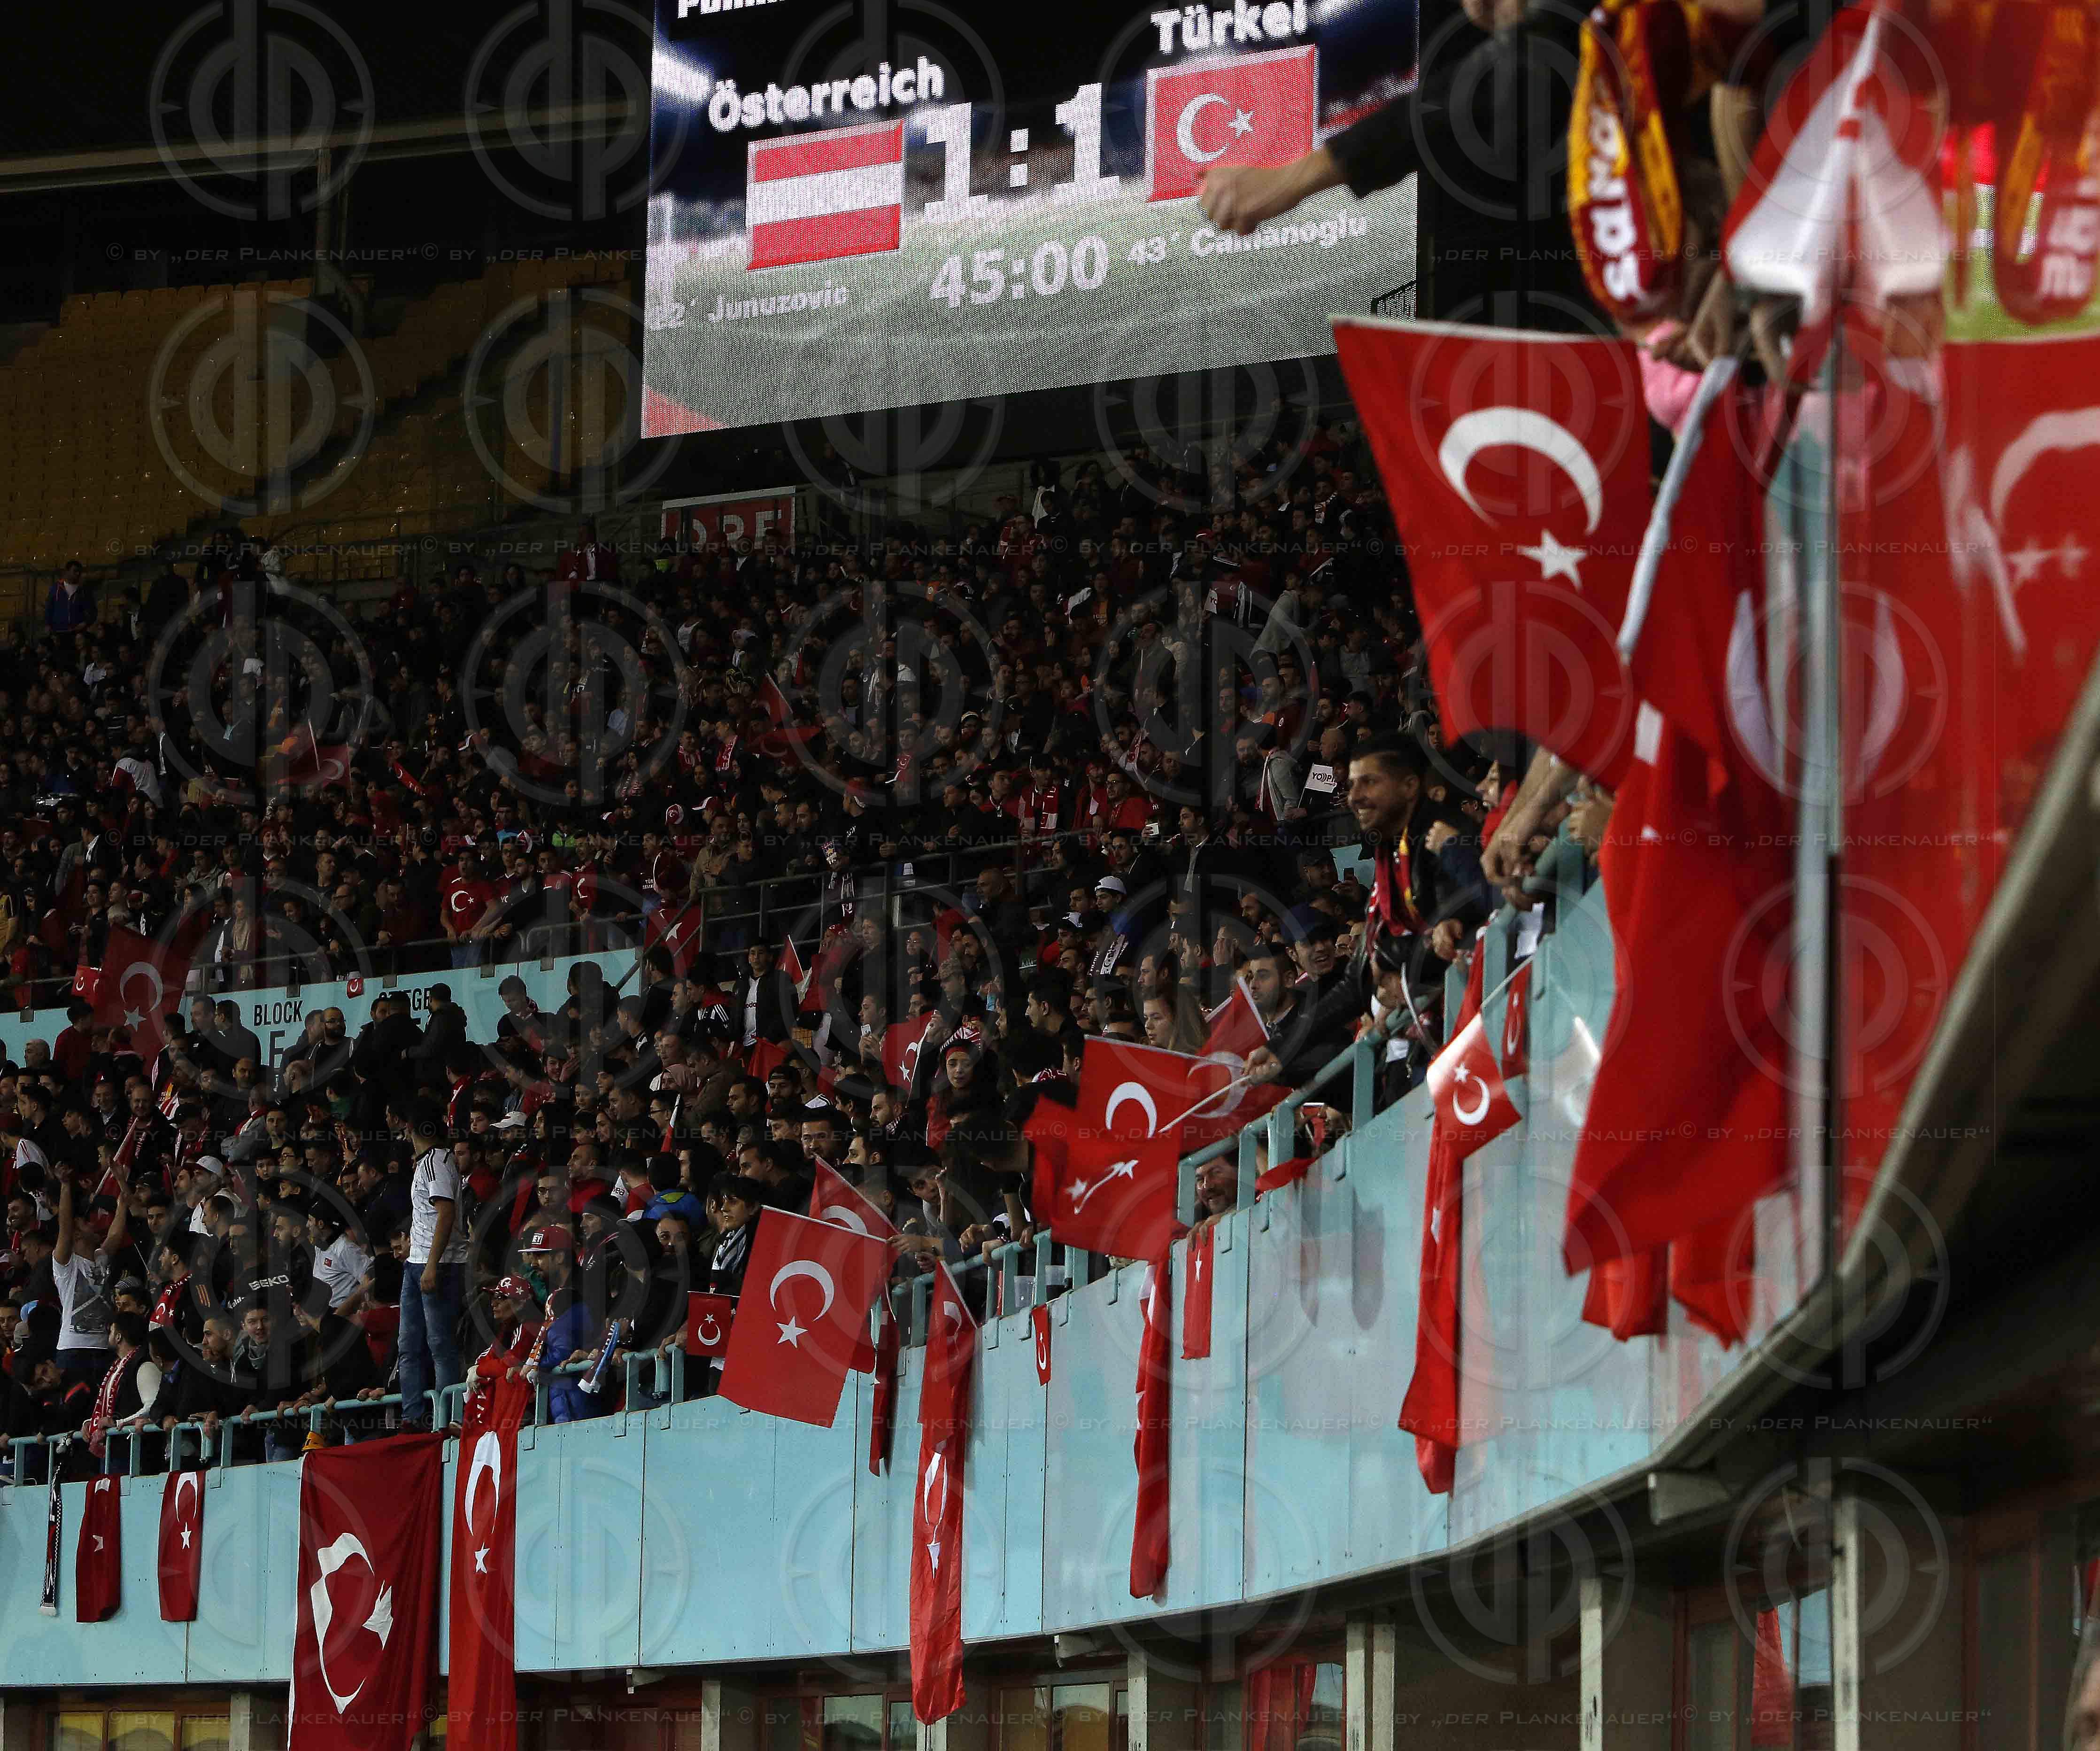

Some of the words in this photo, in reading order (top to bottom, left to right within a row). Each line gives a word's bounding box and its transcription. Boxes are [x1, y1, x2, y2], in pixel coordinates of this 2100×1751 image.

[708, 55, 943, 133] Österreich
[925, 102, 988, 223] 1
[1010, 128, 1029, 187] :
[1055, 83, 1119, 201] 1
[930, 236, 1110, 308] 45:00
[254, 1000, 303, 1026] BLOCK
[248, 1275, 289, 1291] BEKO
